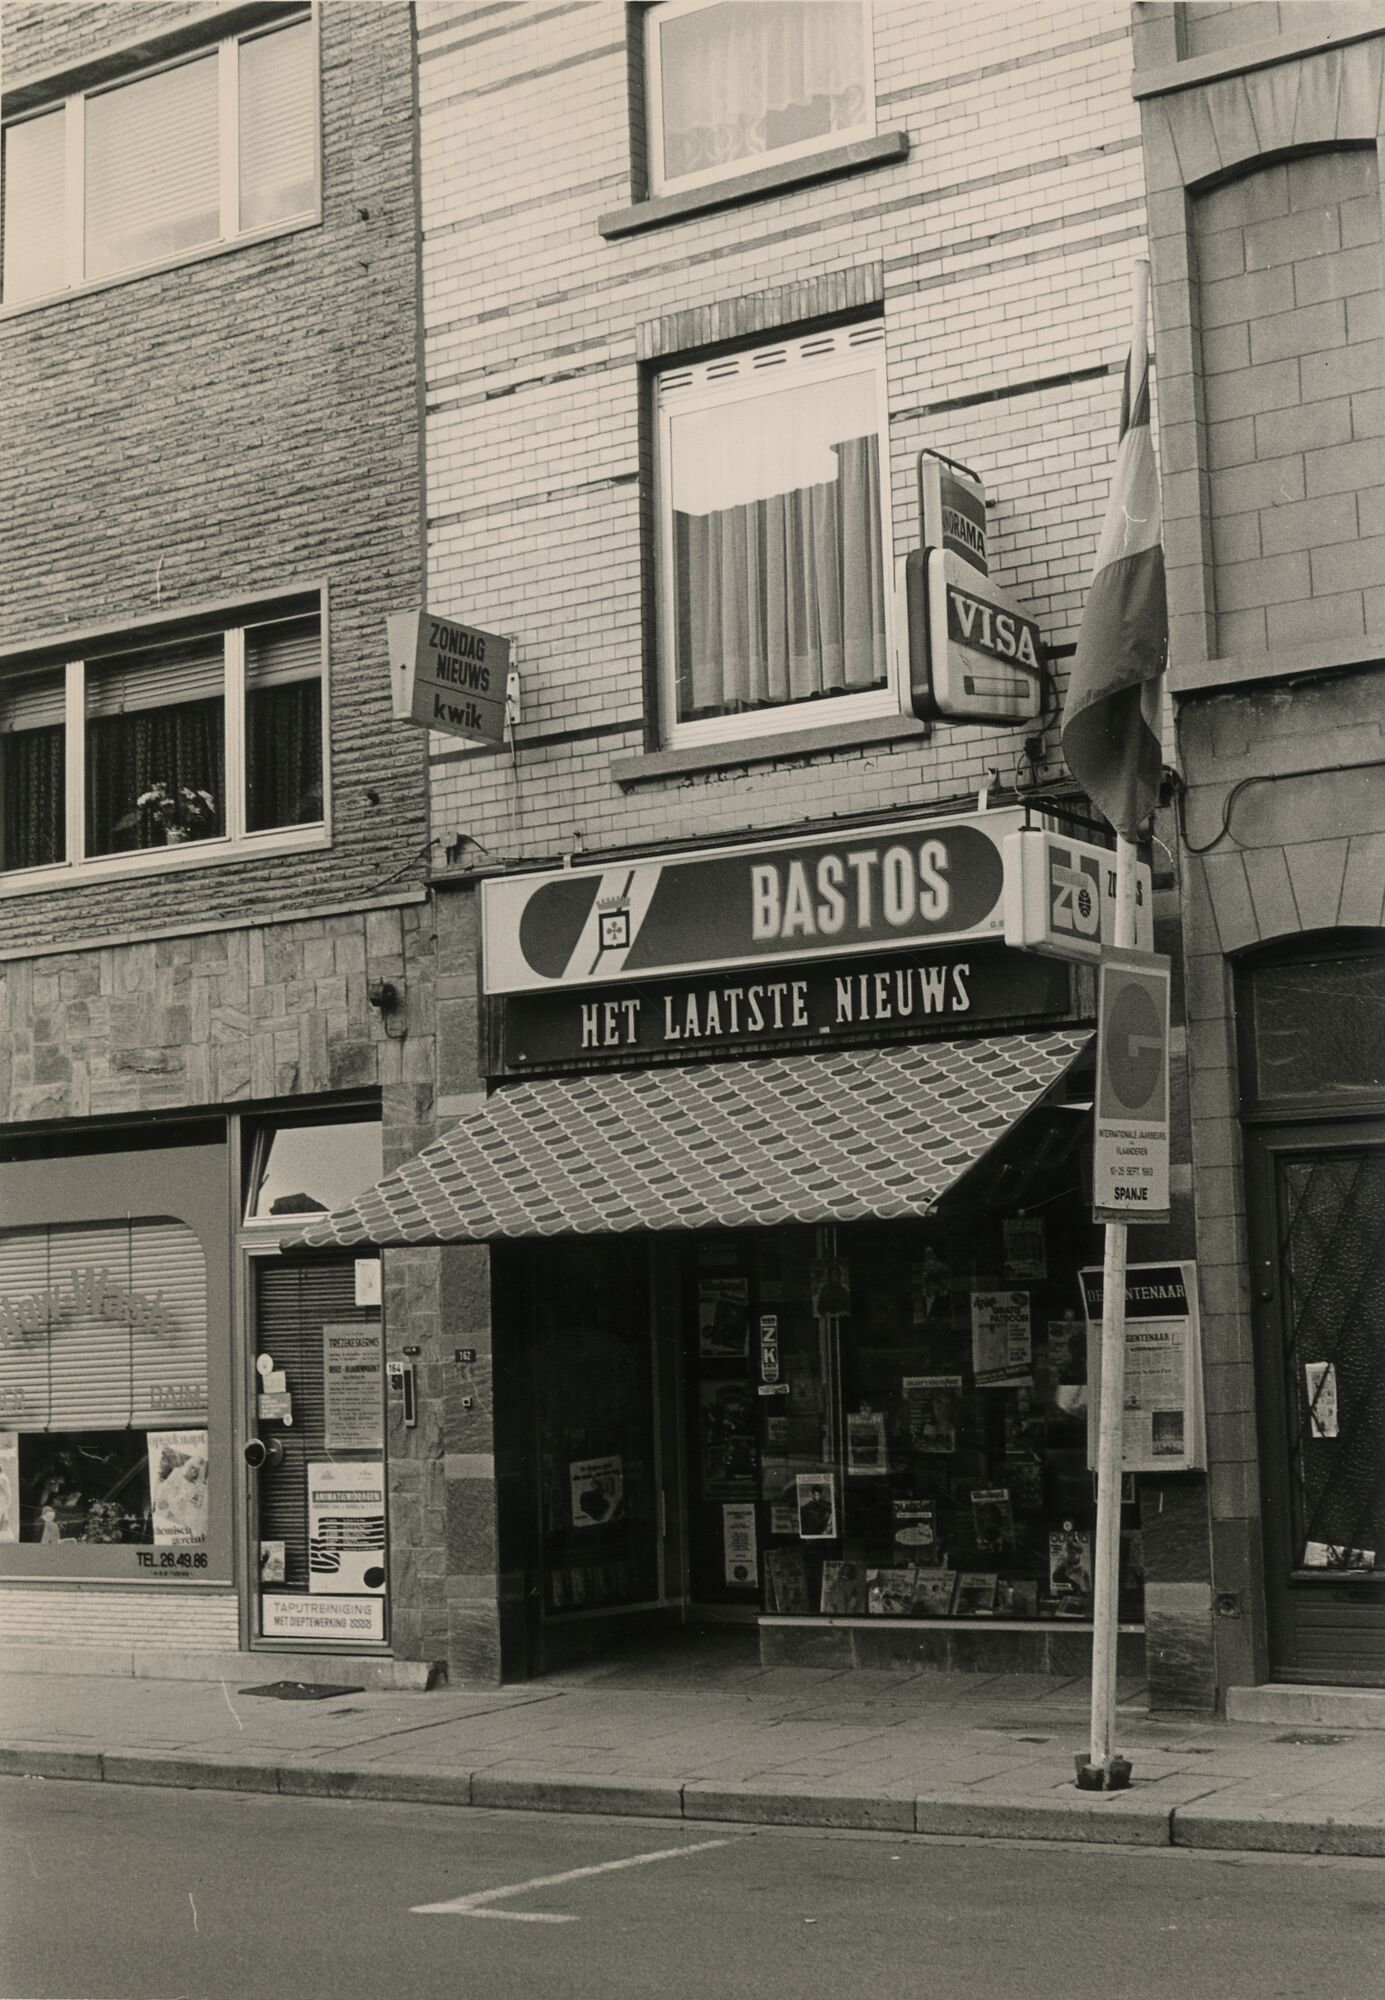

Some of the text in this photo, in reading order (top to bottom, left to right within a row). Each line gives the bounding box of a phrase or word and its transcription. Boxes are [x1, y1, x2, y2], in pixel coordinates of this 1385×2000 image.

[429, 622, 486, 662] ZONDAG
[950, 591, 1040, 669] VISA
[436, 653, 490, 692] NIEUWS
[433, 693, 482, 730] kwik
[750, 839, 950, 942] BASTOS
[581, 963, 971, 1049] HET LAATSTE NIEUWS
[1114, 1187, 1148, 1200] SPANJE
[388, 1363, 401, 1373] 164
[460, 1351, 471, 1360] 162
[274, 1616, 288, 1626] MET
